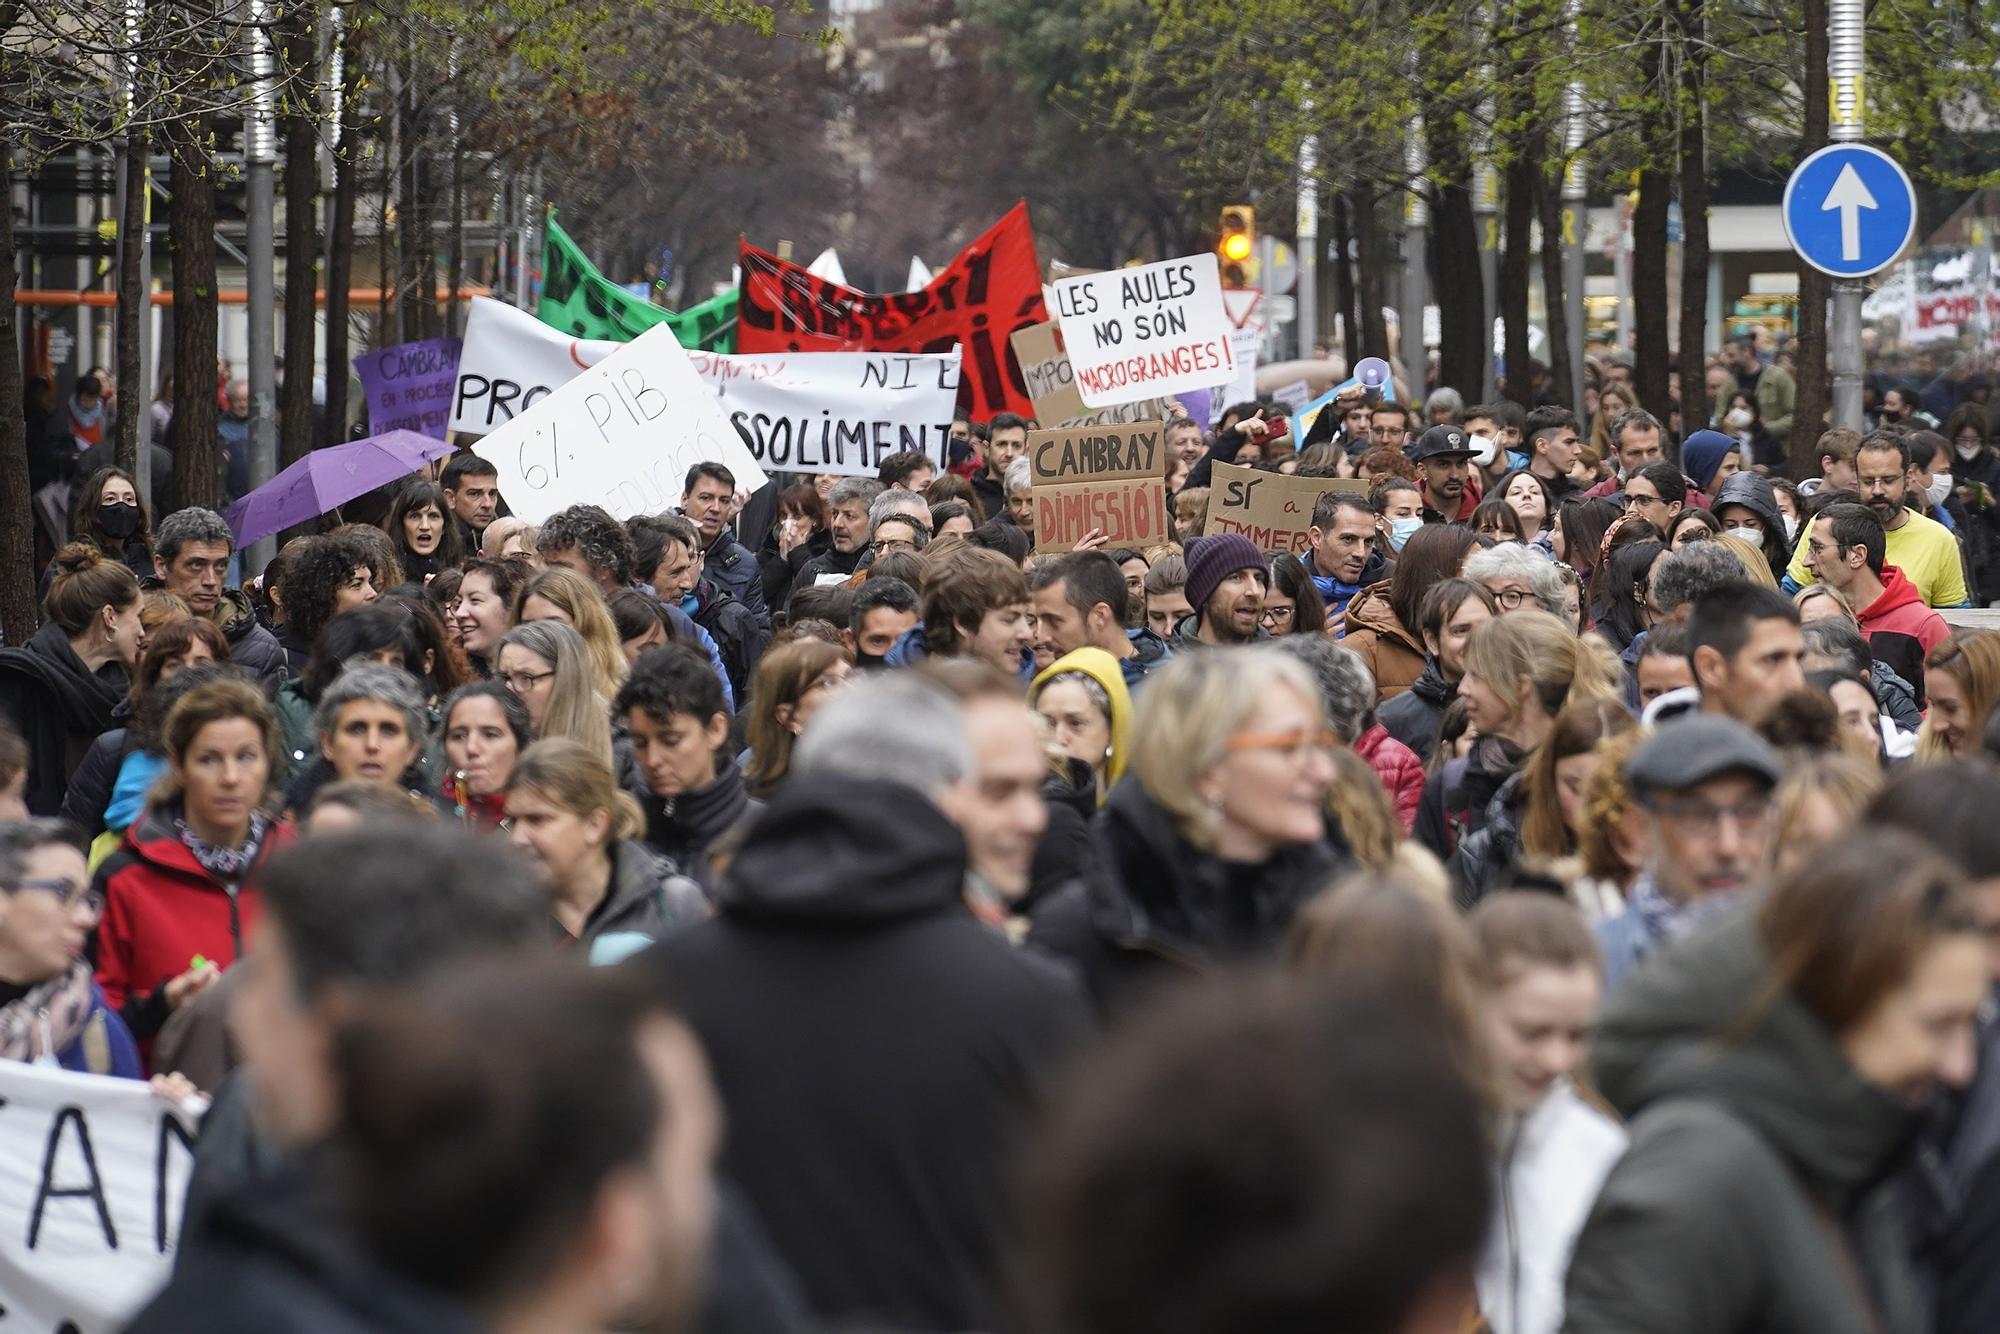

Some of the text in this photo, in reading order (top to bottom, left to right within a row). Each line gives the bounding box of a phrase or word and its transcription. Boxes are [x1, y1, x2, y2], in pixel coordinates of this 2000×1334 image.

[1057, 264, 1196, 317] LES AULES
[1092, 318, 1122, 348] NO
[1135, 303, 1187, 341] SÓN
[859, 357, 923, 390] NI
[1077, 334, 1232, 397] MACROGRANGES!
[518, 367, 668, 490] 6% PIB
[1035, 431, 1158, 477] CAMBRAY
[1222, 478, 1263, 510] SÍ
[1283, 499, 1300, 513] a
